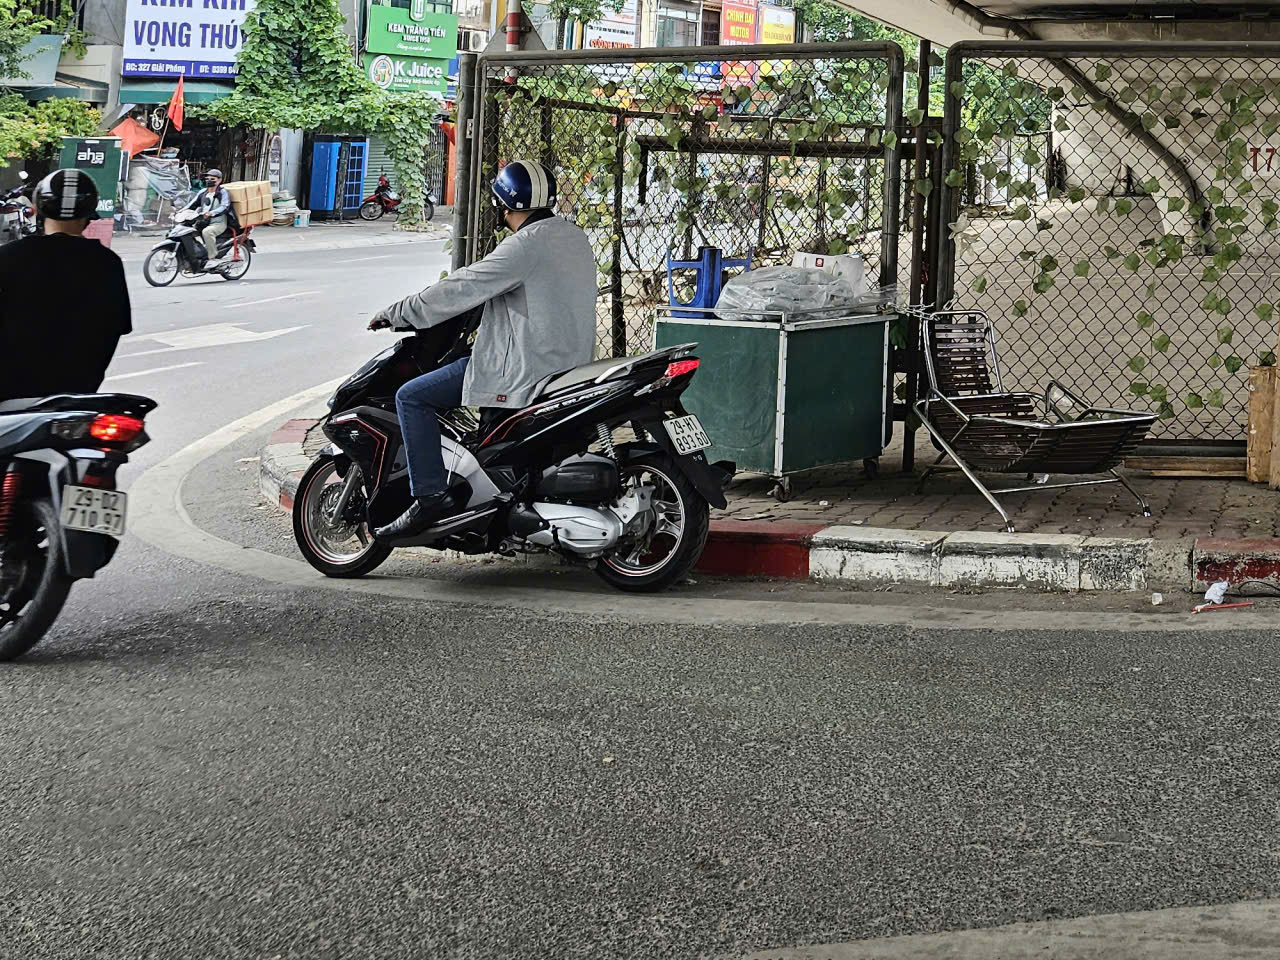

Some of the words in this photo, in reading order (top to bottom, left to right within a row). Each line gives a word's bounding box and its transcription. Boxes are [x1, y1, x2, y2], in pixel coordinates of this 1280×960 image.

[134, 20, 192, 52] VỌNG
[387, 23, 405, 34] KEM
[407, 62, 443, 78] Juice
[77, 147, 105, 160] aha
[670, 417, 697, 435] 29-H1
